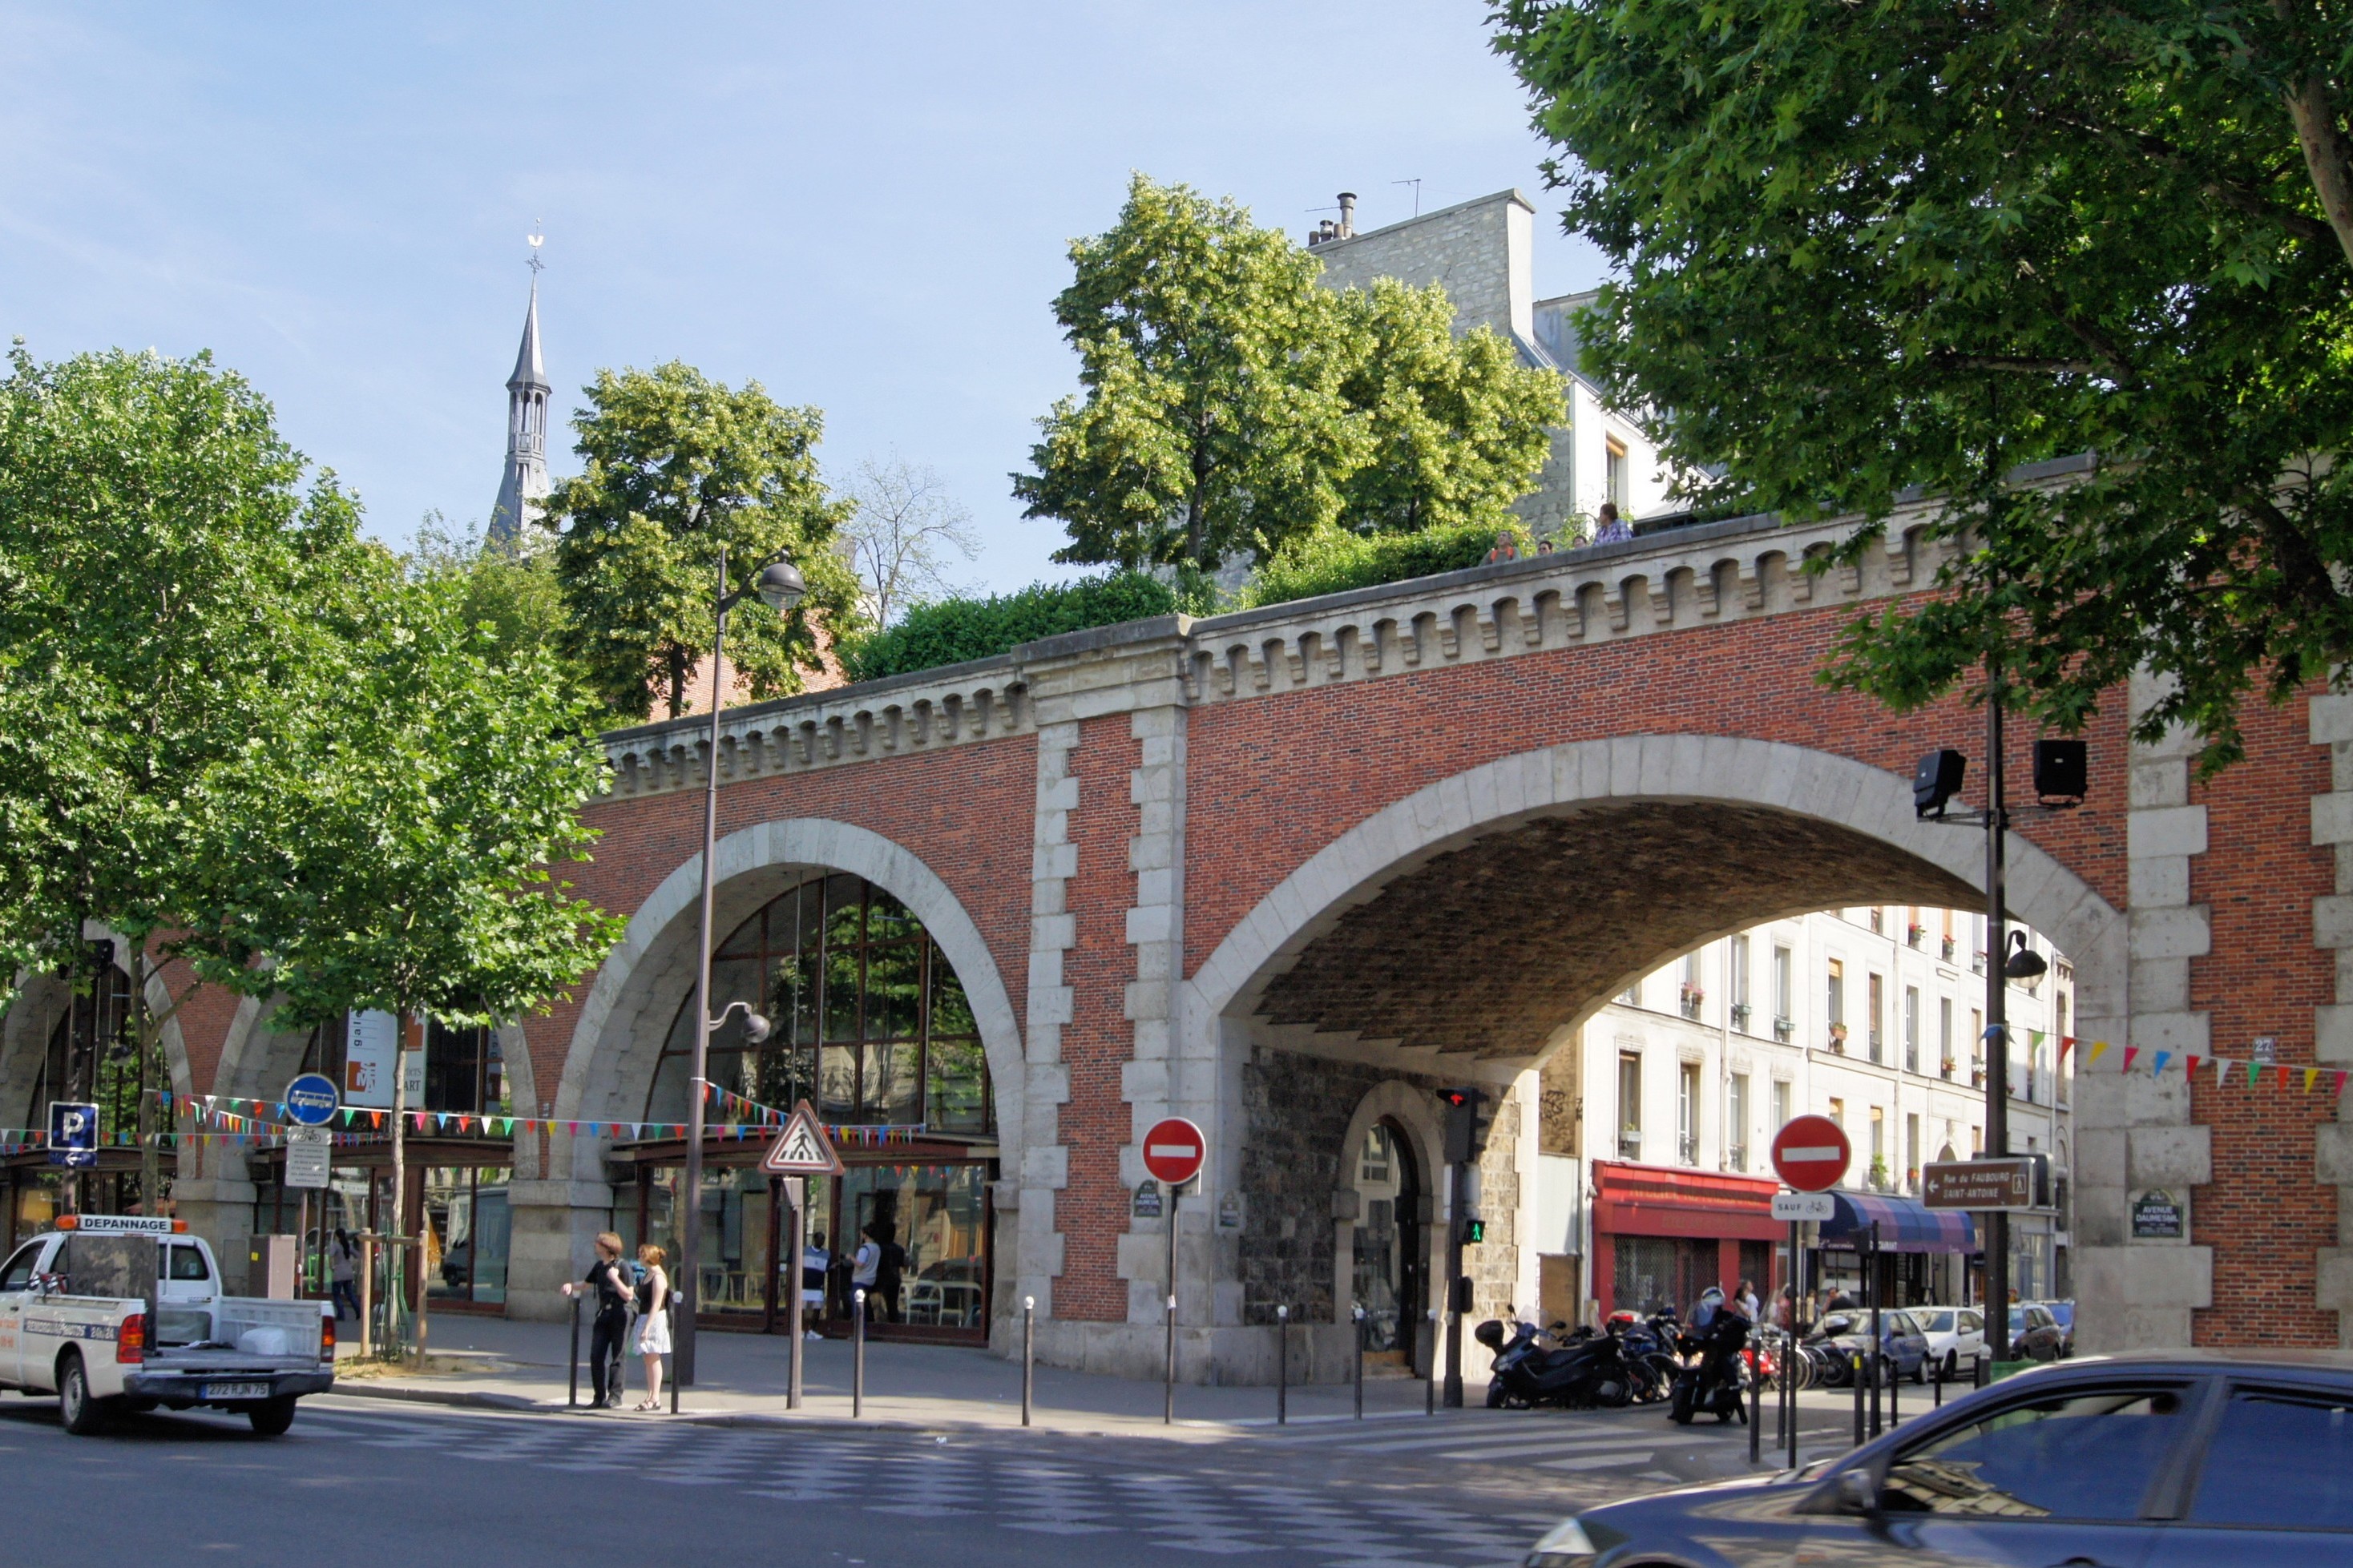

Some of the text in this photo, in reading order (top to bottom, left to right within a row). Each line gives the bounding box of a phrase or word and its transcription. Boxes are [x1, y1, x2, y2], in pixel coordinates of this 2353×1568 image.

[2255, 1040, 2271, 1050] 27
[63, 1112, 84, 1141] P
[1943, 1172, 2010, 1183] Rue du FAUBOURG
[1943, 1188, 1999, 1199] SAINT-ANTOINE
[2143, 1206, 2173, 1214] AVENUE
[2136, 1214, 2178, 1223] DAUMESNIL
[85, 1219, 167, 1230] DEPANNAGE
